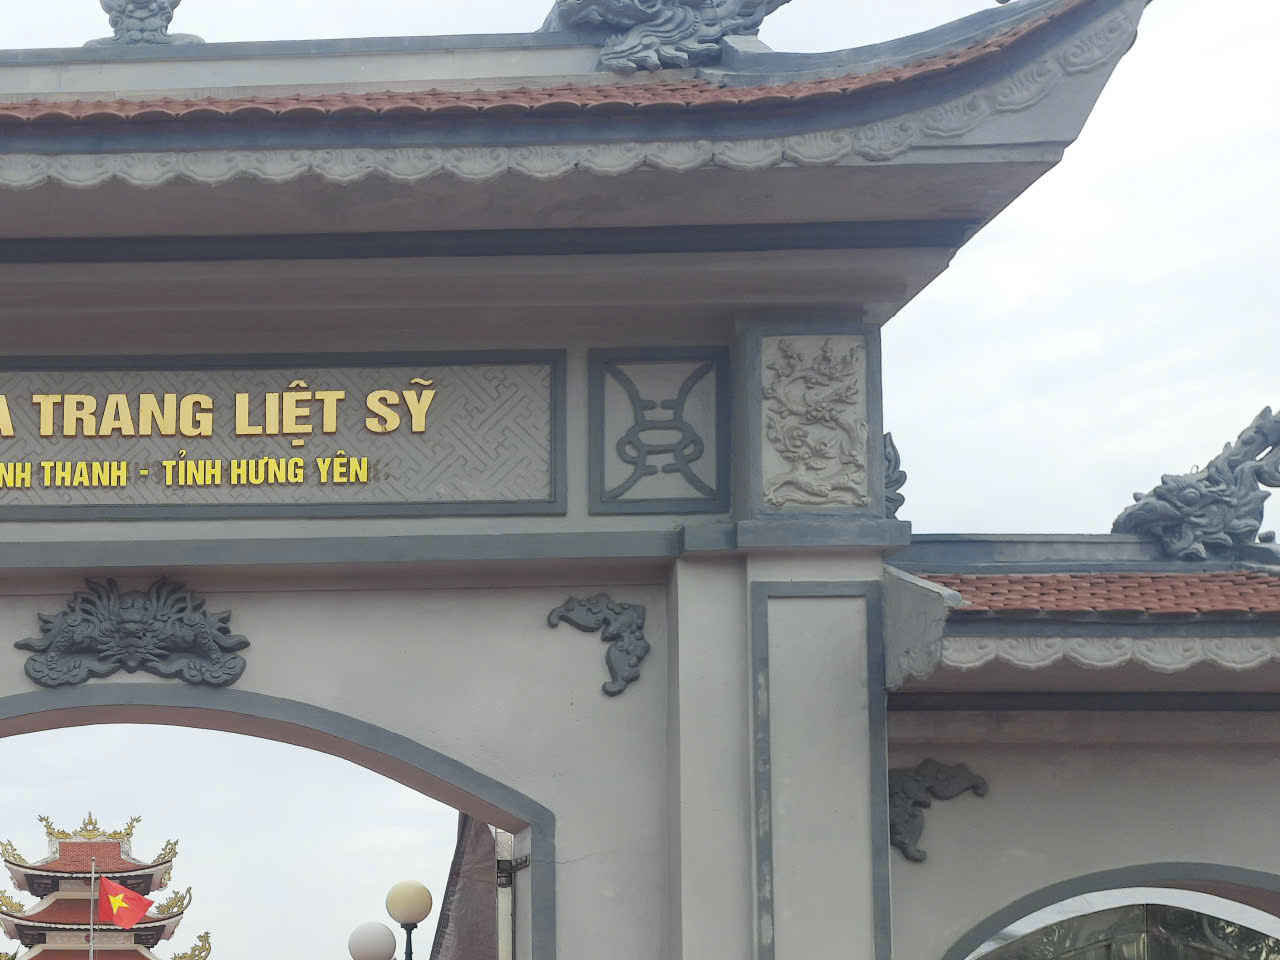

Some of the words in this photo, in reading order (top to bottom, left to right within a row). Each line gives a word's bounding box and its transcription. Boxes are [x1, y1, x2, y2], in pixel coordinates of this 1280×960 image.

[32, 393, 214, 438] TRANG
[235, 379, 346, 447] LIỆT
[365, 377, 437, 434] SỸ
[40, 460, 128, 488] THANH
[162, 449, 222, 486] TỈNH
[230, 456, 304, 486] HƯNG
[315, 449, 368, 484] YÊN
